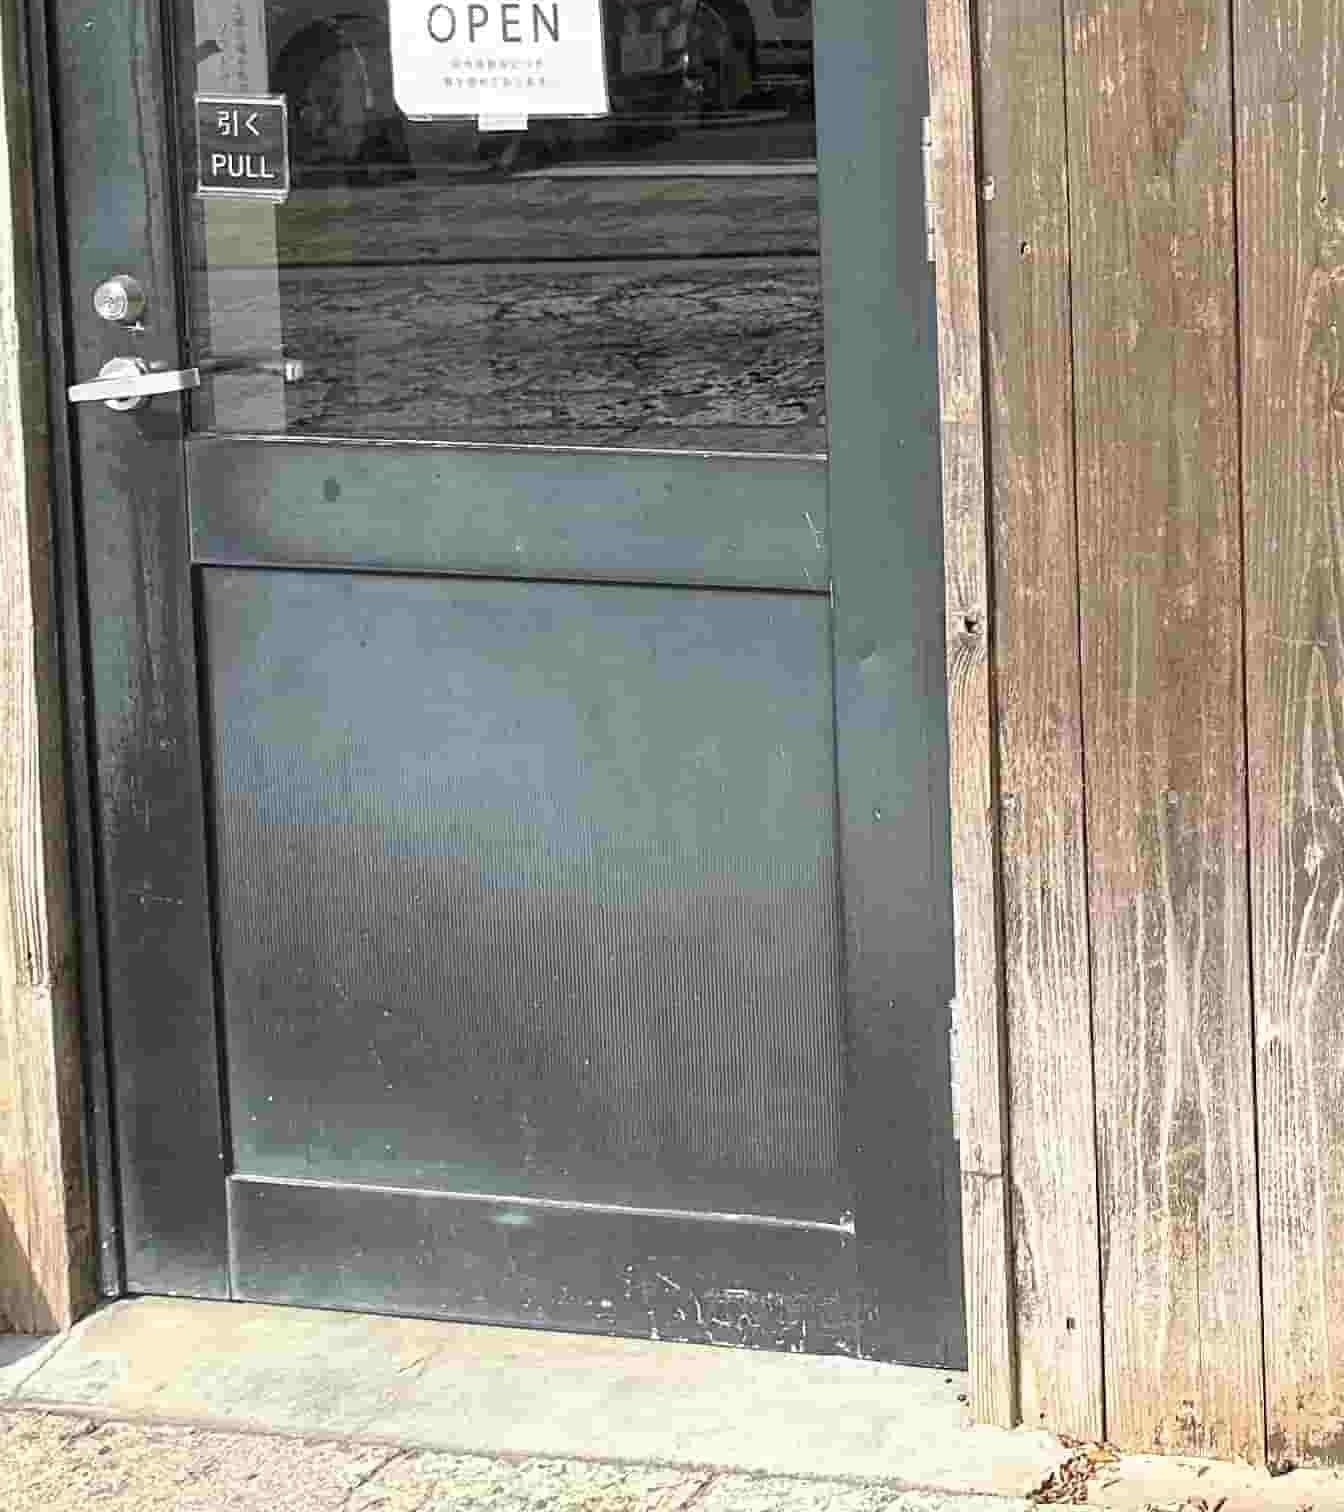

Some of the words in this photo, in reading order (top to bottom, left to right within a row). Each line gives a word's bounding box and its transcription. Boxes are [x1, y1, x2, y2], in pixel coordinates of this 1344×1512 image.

[427, 2, 560, 44] OPEN
[216, 109, 262, 137] 引く
[210, 153, 276, 179] PULL
